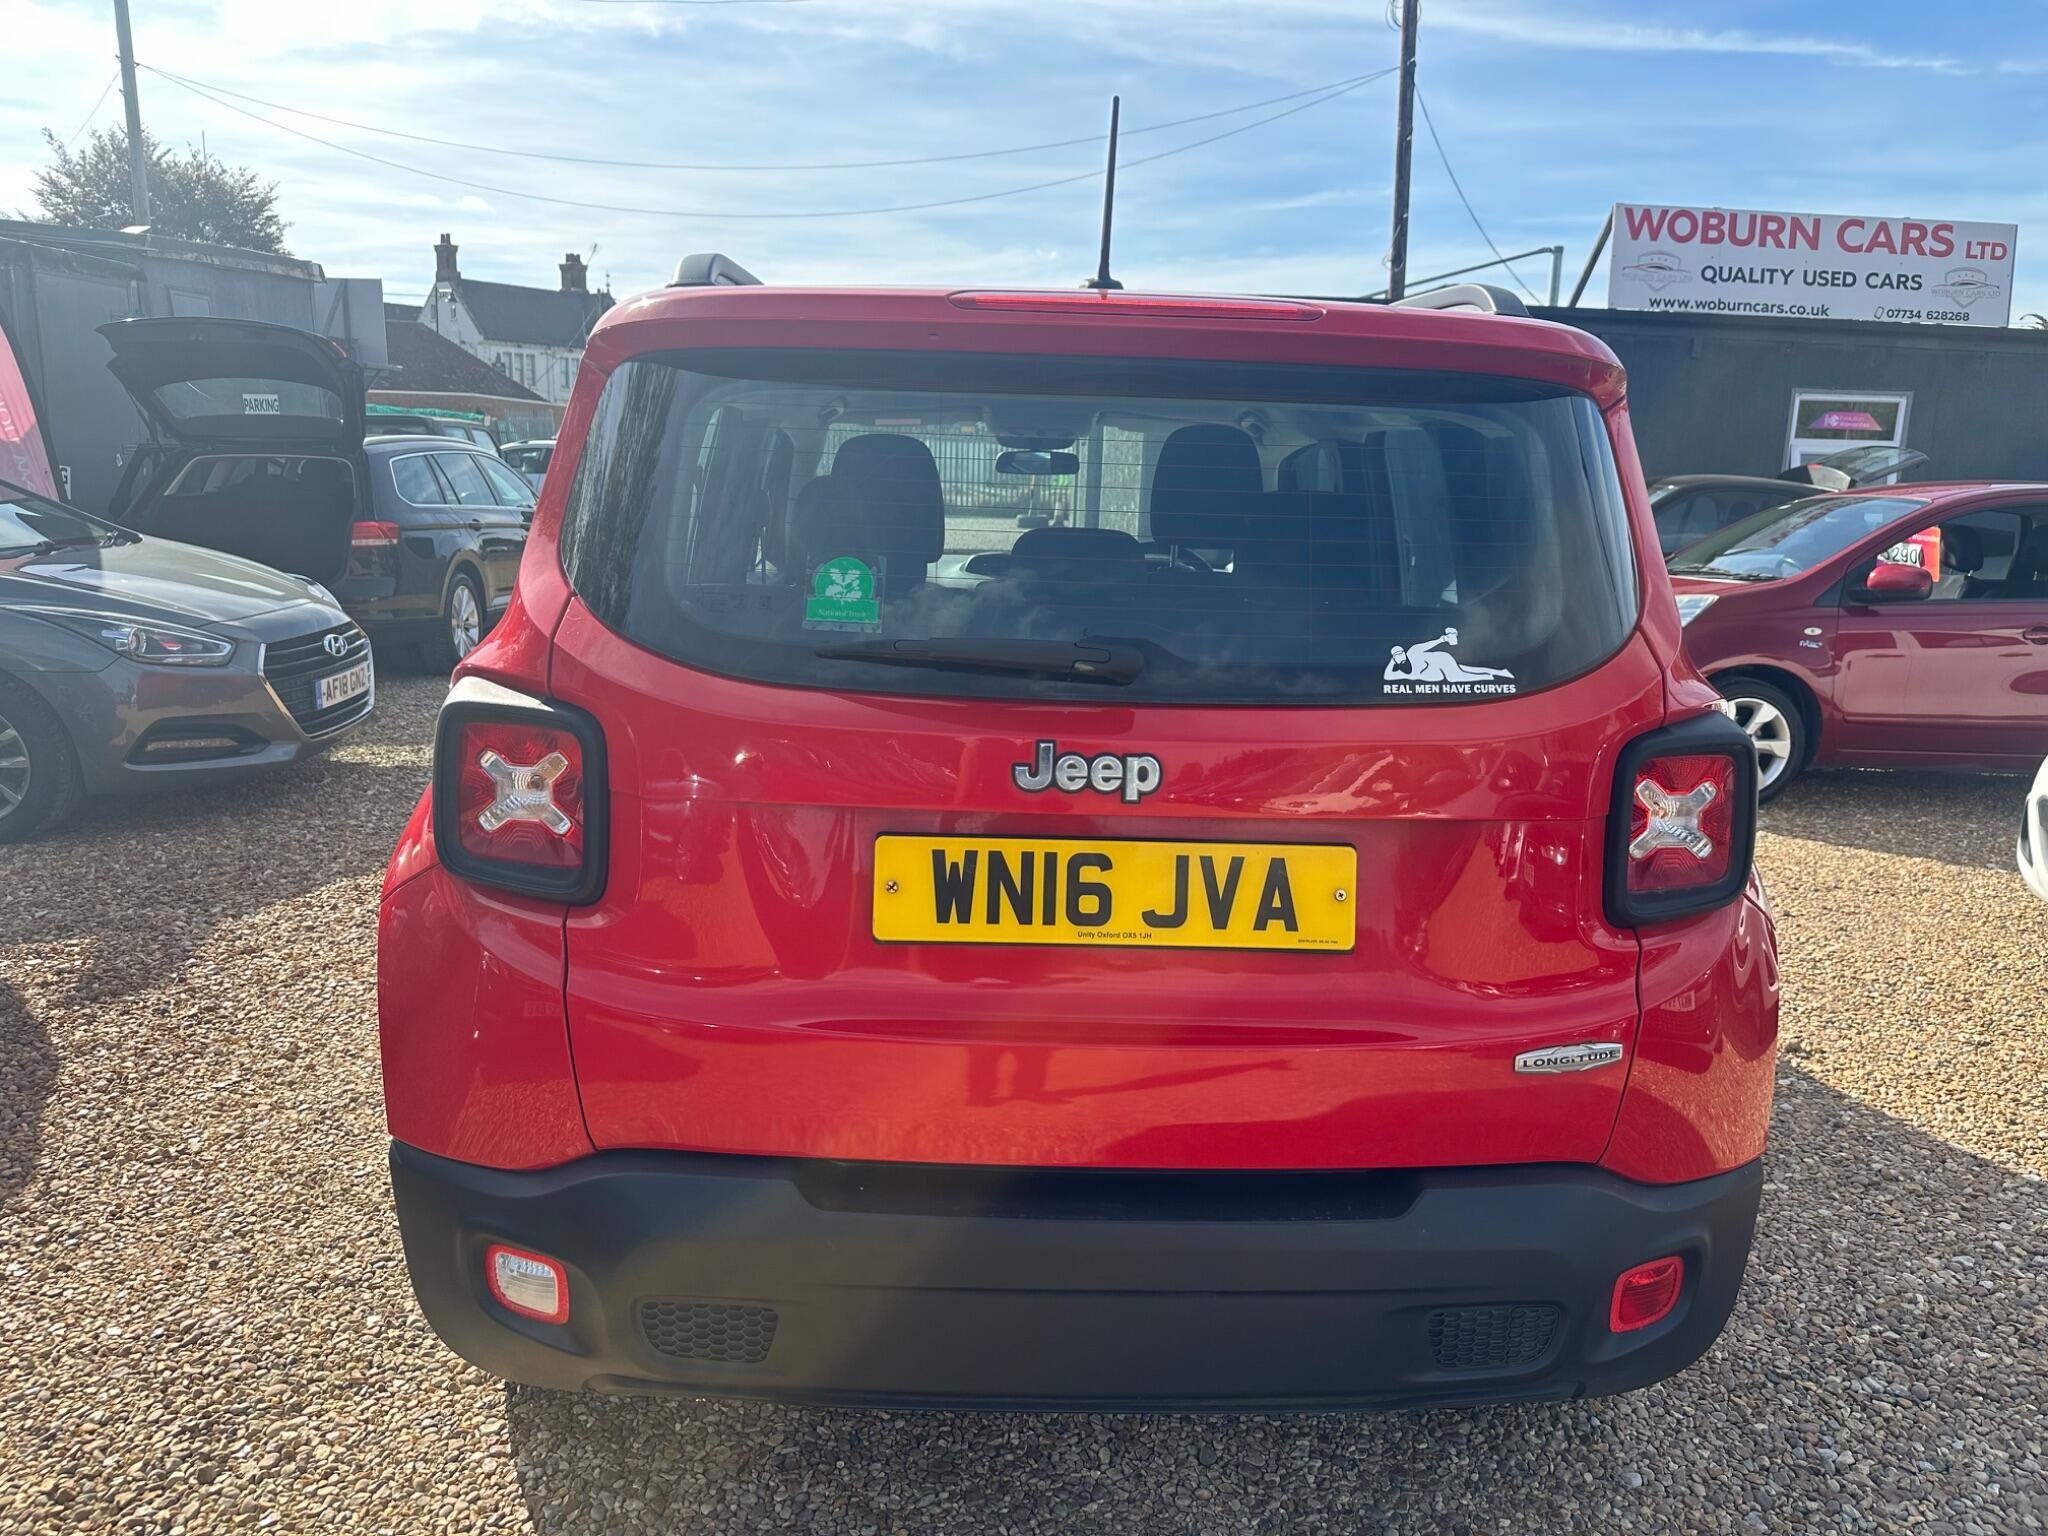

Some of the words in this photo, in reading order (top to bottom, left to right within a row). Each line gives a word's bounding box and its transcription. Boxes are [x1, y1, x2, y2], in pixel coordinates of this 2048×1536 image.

[1623, 207, 1821, 251] WOBURN
[1836, 218, 1955, 258] CARS
[1966, 240, 2008, 261] LTD
[1701, 265, 1794, 286] QUALITY
[1803, 270, 1857, 288] USED
[1865, 272, 1922, 291] CARS
[1649, 297, 1830, 317] www.woburncars.co.uk
[1886, 308, 1922, 320] 07734
[1926, 310, 1970, 321] 628268
[243, 398, 280, 413] PARKING
[326, 675, 348, 702] AF18
[349, 666, 366, 692] GNZ
[1384, 684, 1412, 694] REAL
[1415, 684, 1439, 694] MEN
[1443, 684, 1471, 694] HAVE
[1473, 684, 1516, 694] CURVES
[1015, 742, 1161, 802] Jeep
[931, 849, 1113, 926] WN16
[1141, 855, 1299, 932] JVA
[1077, 931, 1095, 940] Unity
[1097, 931, 1121, 939] Oxford
[1523, 1050, 1618, 1068] LONGITUDE
